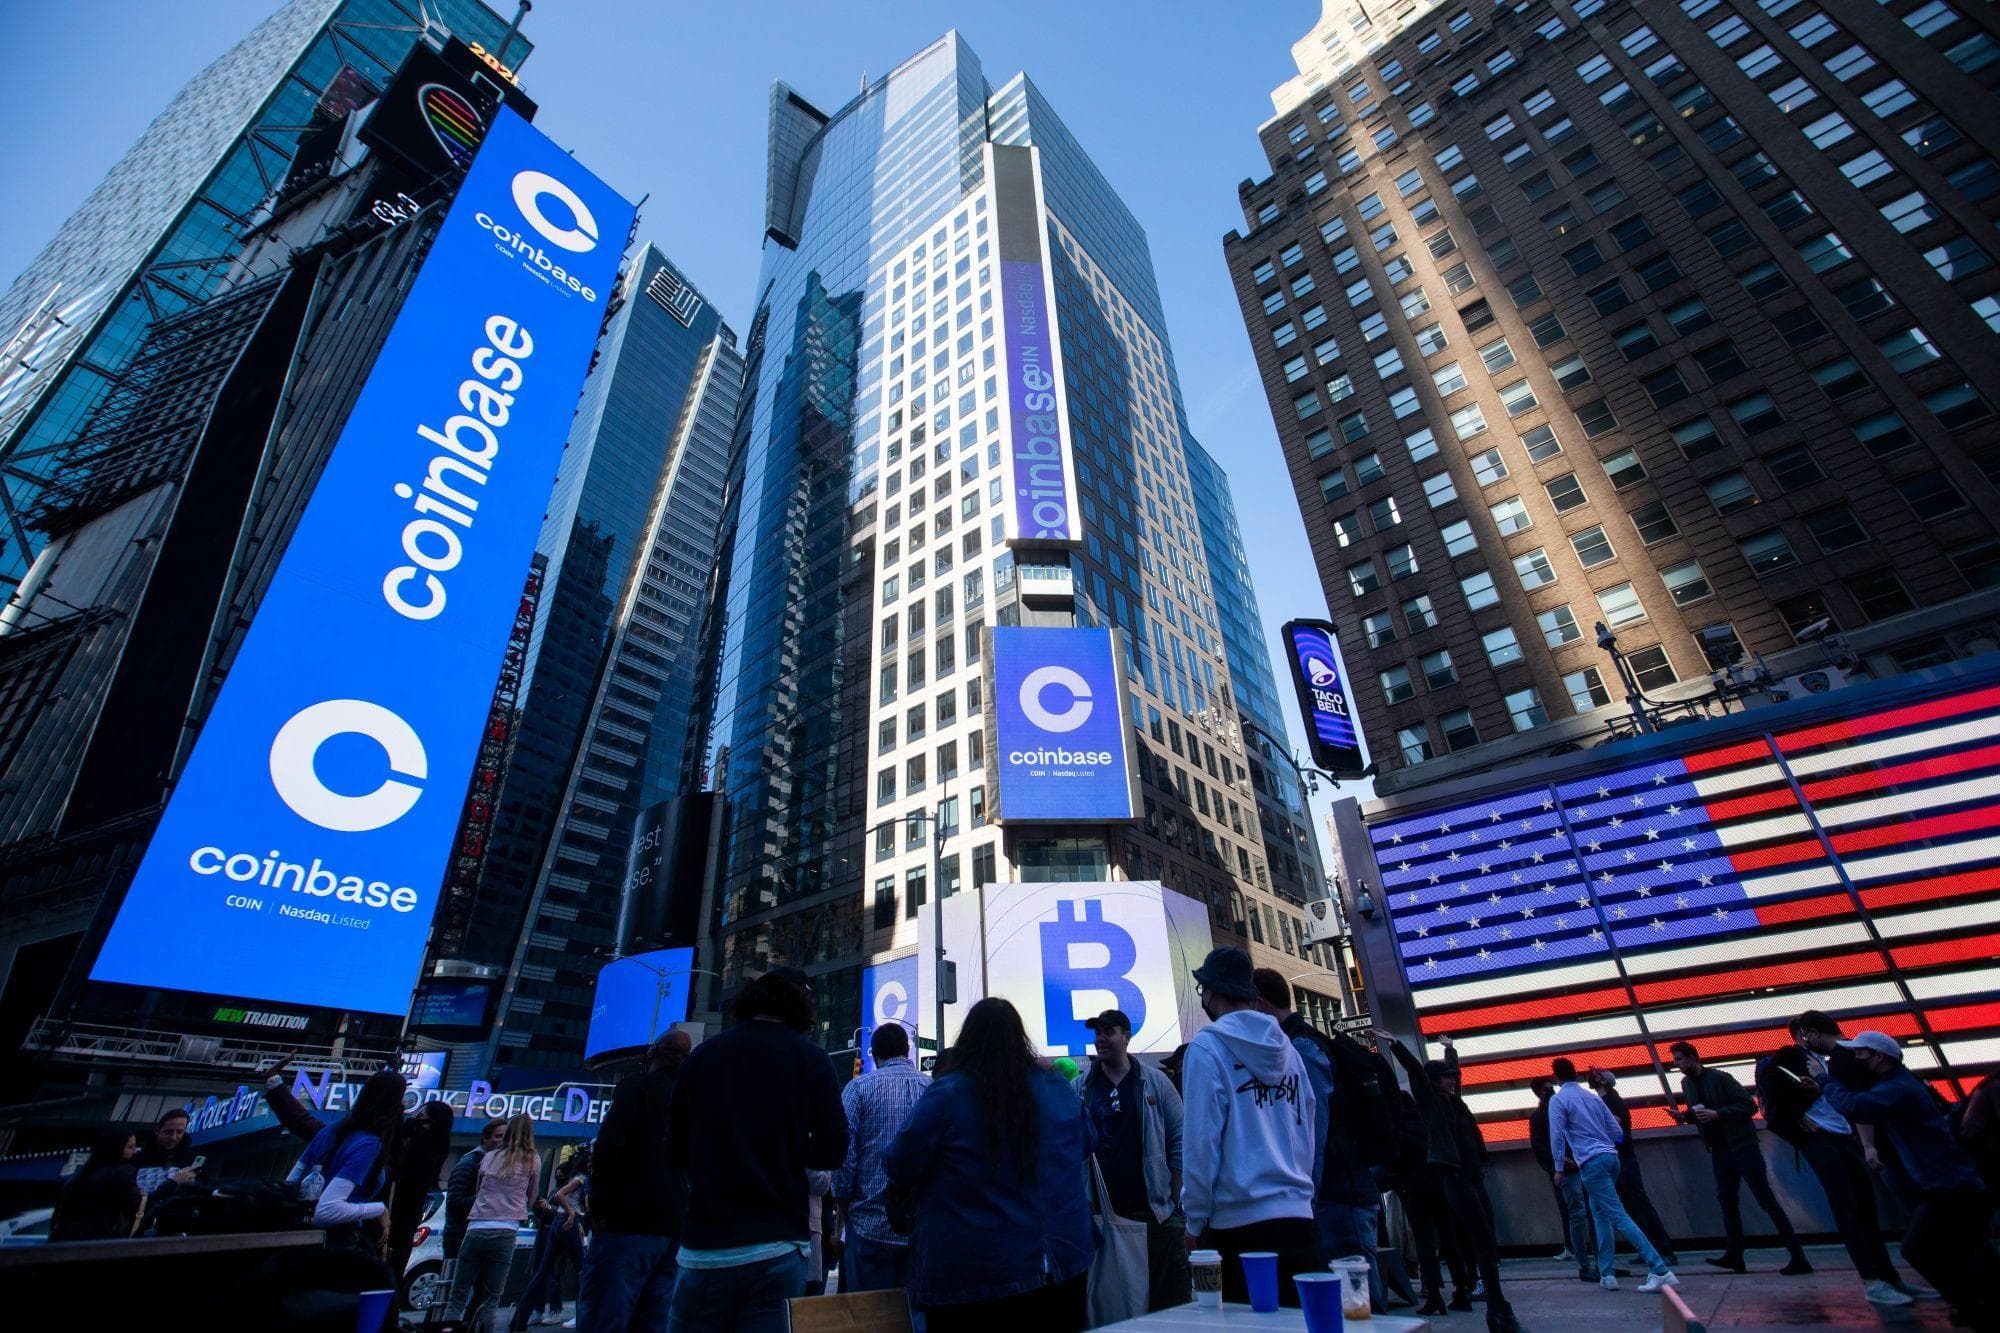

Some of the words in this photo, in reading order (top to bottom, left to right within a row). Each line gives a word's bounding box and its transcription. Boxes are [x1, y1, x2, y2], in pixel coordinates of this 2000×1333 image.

[475, 212, 597, 302] coinbase
[495, 243, 514, 259] COIN
[522, 262, 550, 285] Nasdaq
[383, 315, 534, 621] coinbase
[1311, 688, 1343, 704] TACO
[1317, 699, 1347, 716] BELL
[1009, 746, 1113, 765] coinbase
[1053, 770, 1075, 778] Nasdaq
[190, 846, 418, 913] coinbase
[226, 895, 263, 911] COIN
[279, 904, 330, 924] Nasdaq
[332, 914, 370, 930] Listed
[402, 1088, 459, 1114] ORK
[464, 1080, 554, 1121] POLICE
